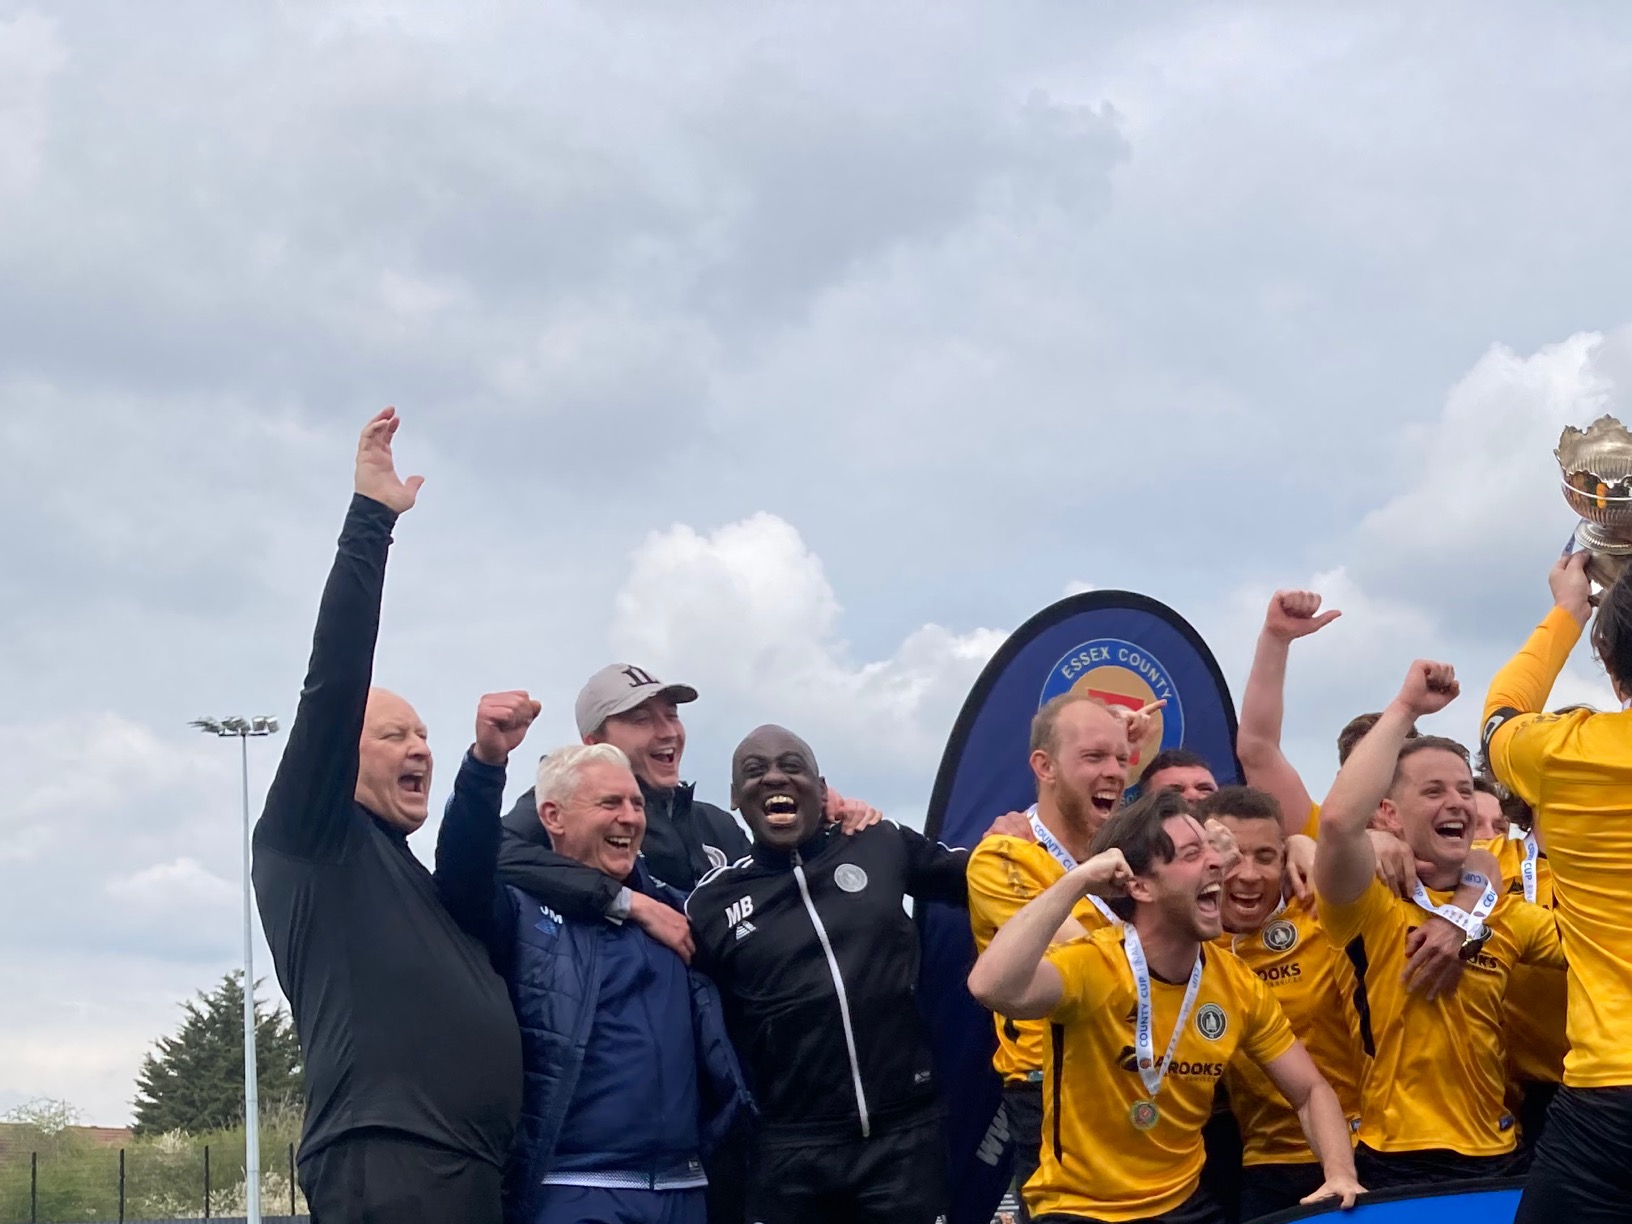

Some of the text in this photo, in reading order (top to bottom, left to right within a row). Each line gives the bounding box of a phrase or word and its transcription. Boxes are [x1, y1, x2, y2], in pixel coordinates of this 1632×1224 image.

[1061, 646, 1173, 699] ESSEX COUNTY
[1034, 823, 1075, 872] COUNTY CU
[1523, 862, 1533, 881] CUP
[725, 895, 755, 928] MB
[1256, 963, 1302, 982] OOKS
[1138, 976, 1149, 1048] COUNTY CUP
